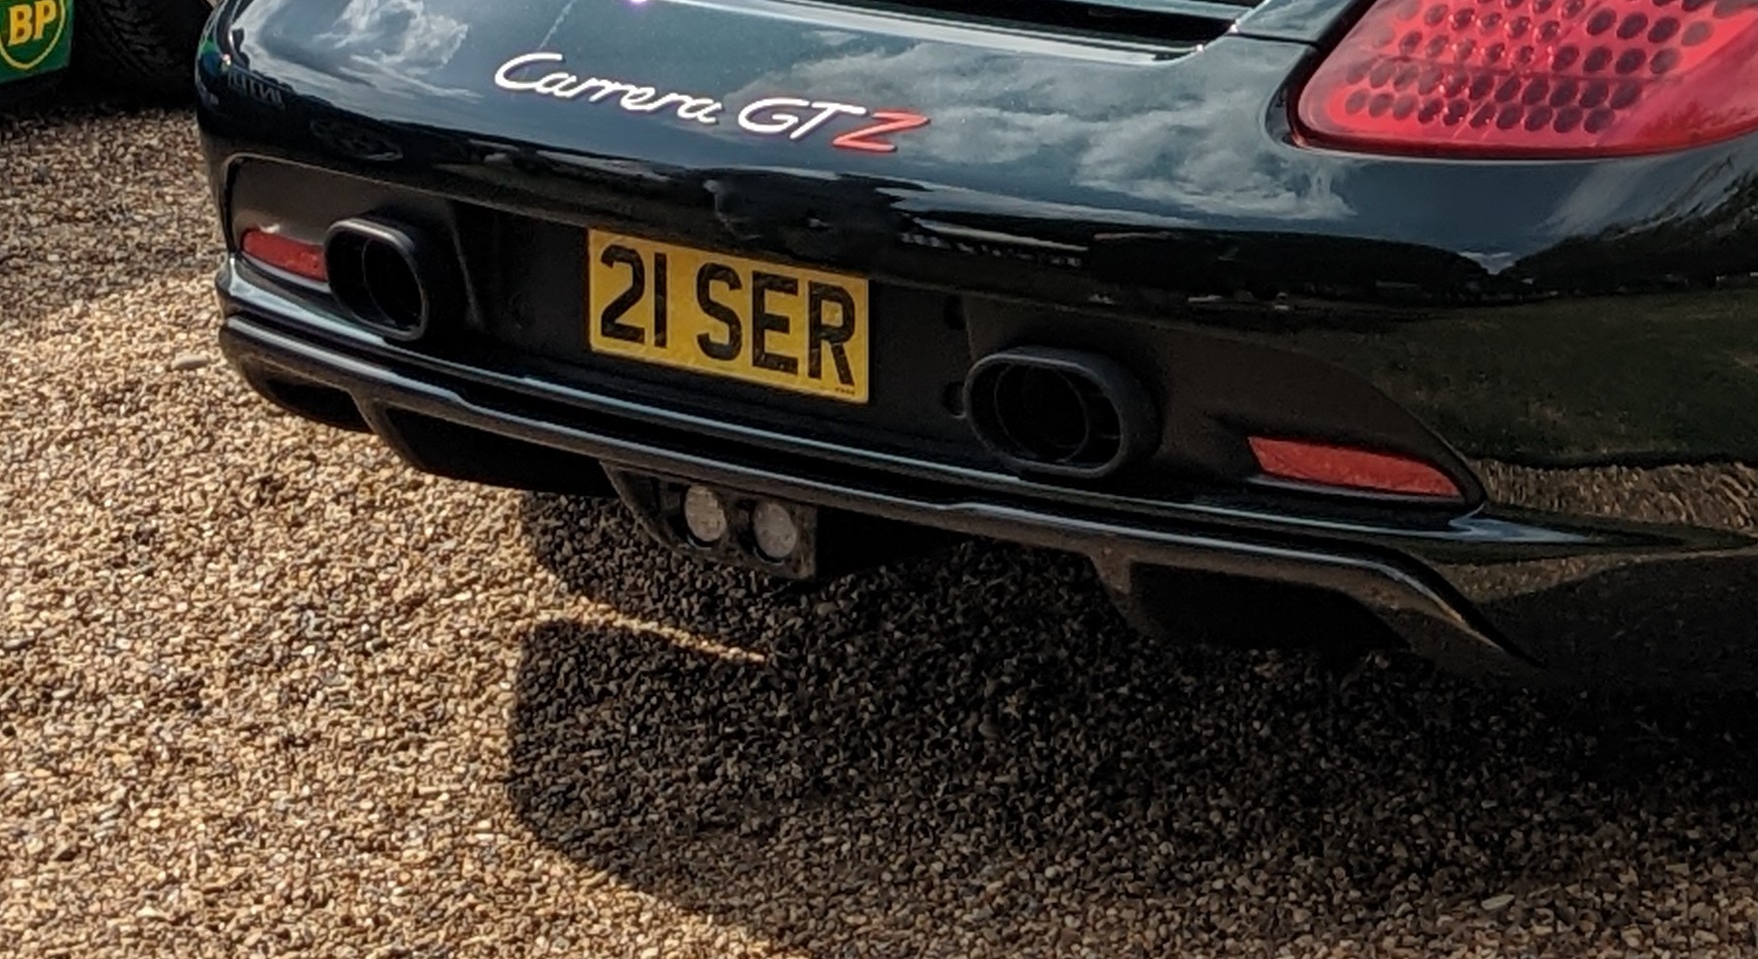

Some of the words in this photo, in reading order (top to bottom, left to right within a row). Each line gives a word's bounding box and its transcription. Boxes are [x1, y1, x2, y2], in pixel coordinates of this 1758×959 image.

[494, 51, 725, 126] Carrera
[600, 244, 668, 348] 21
[696, 262, 856, 387] SER
